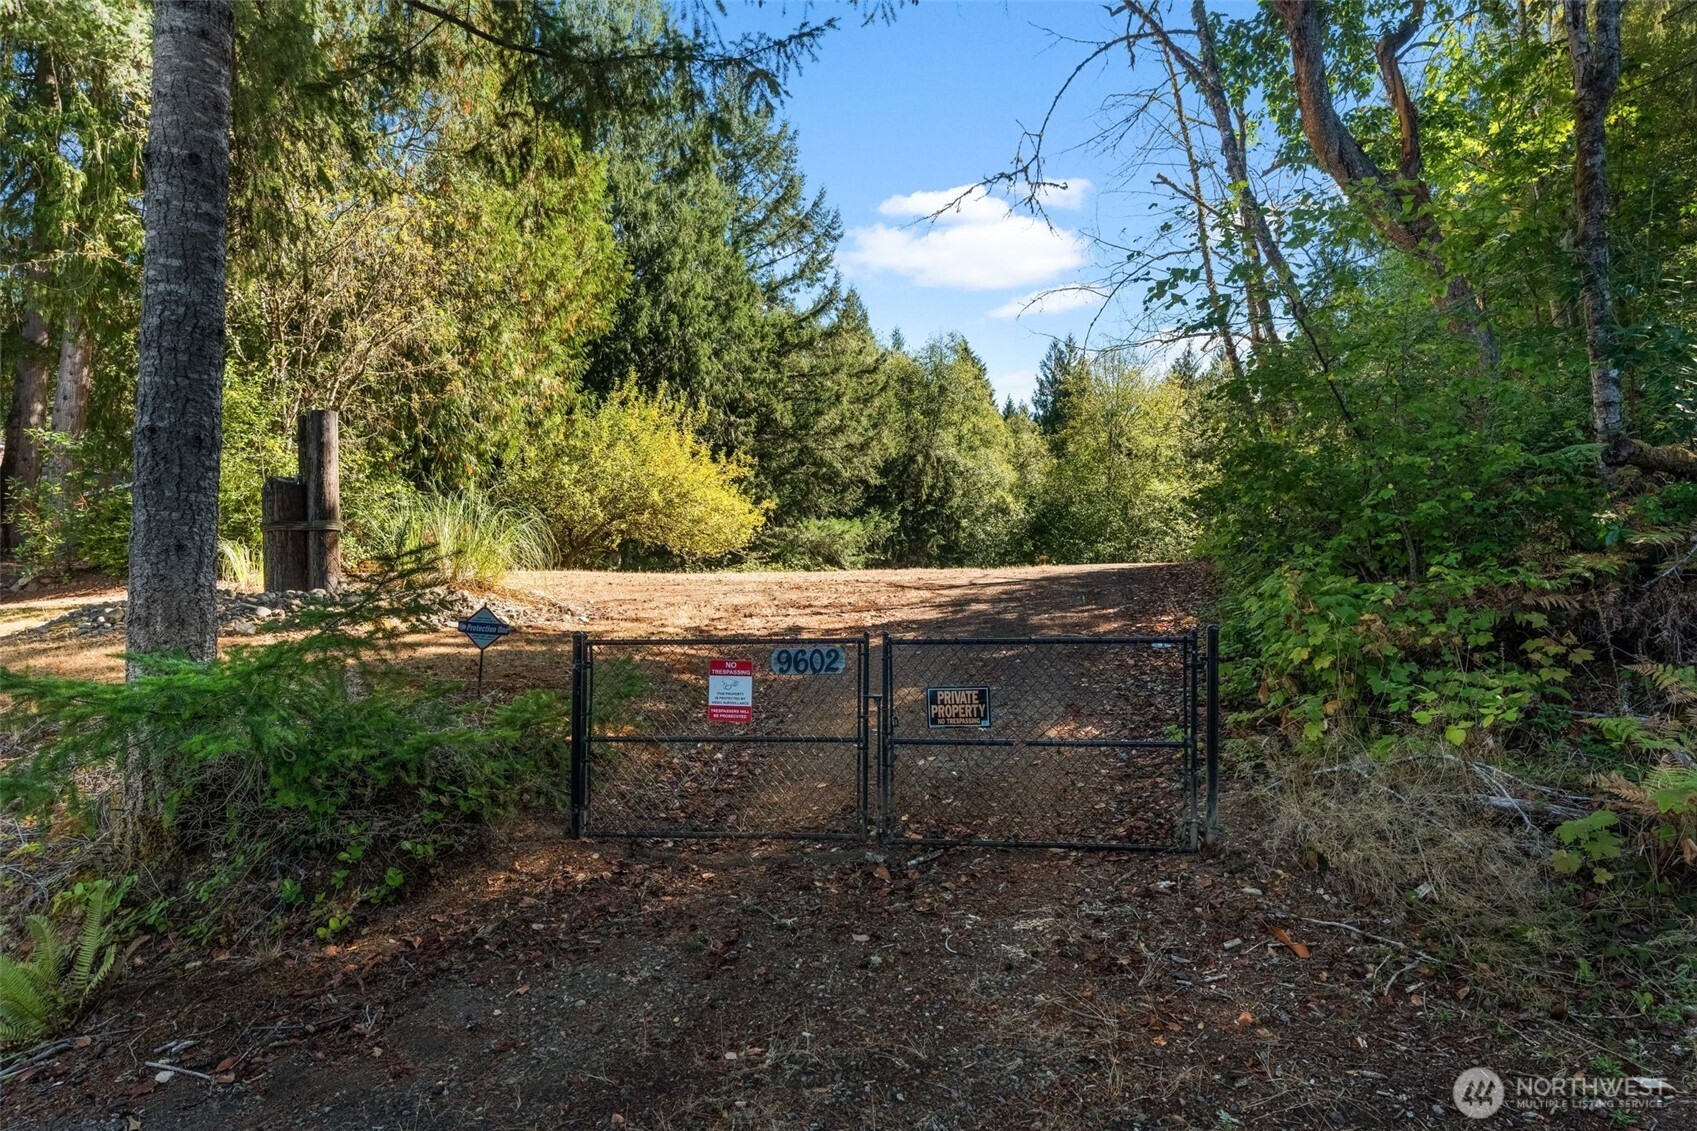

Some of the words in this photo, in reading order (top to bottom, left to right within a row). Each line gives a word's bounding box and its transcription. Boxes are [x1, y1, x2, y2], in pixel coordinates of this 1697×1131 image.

[466, 624, 497, 633] Protection
[725, 661, 737, 669] NO
[777, 649, 840, 674] 9602
[937, 690, 979, 704] PRIVATE
[930, 704, 986, 718] PROPERTY
